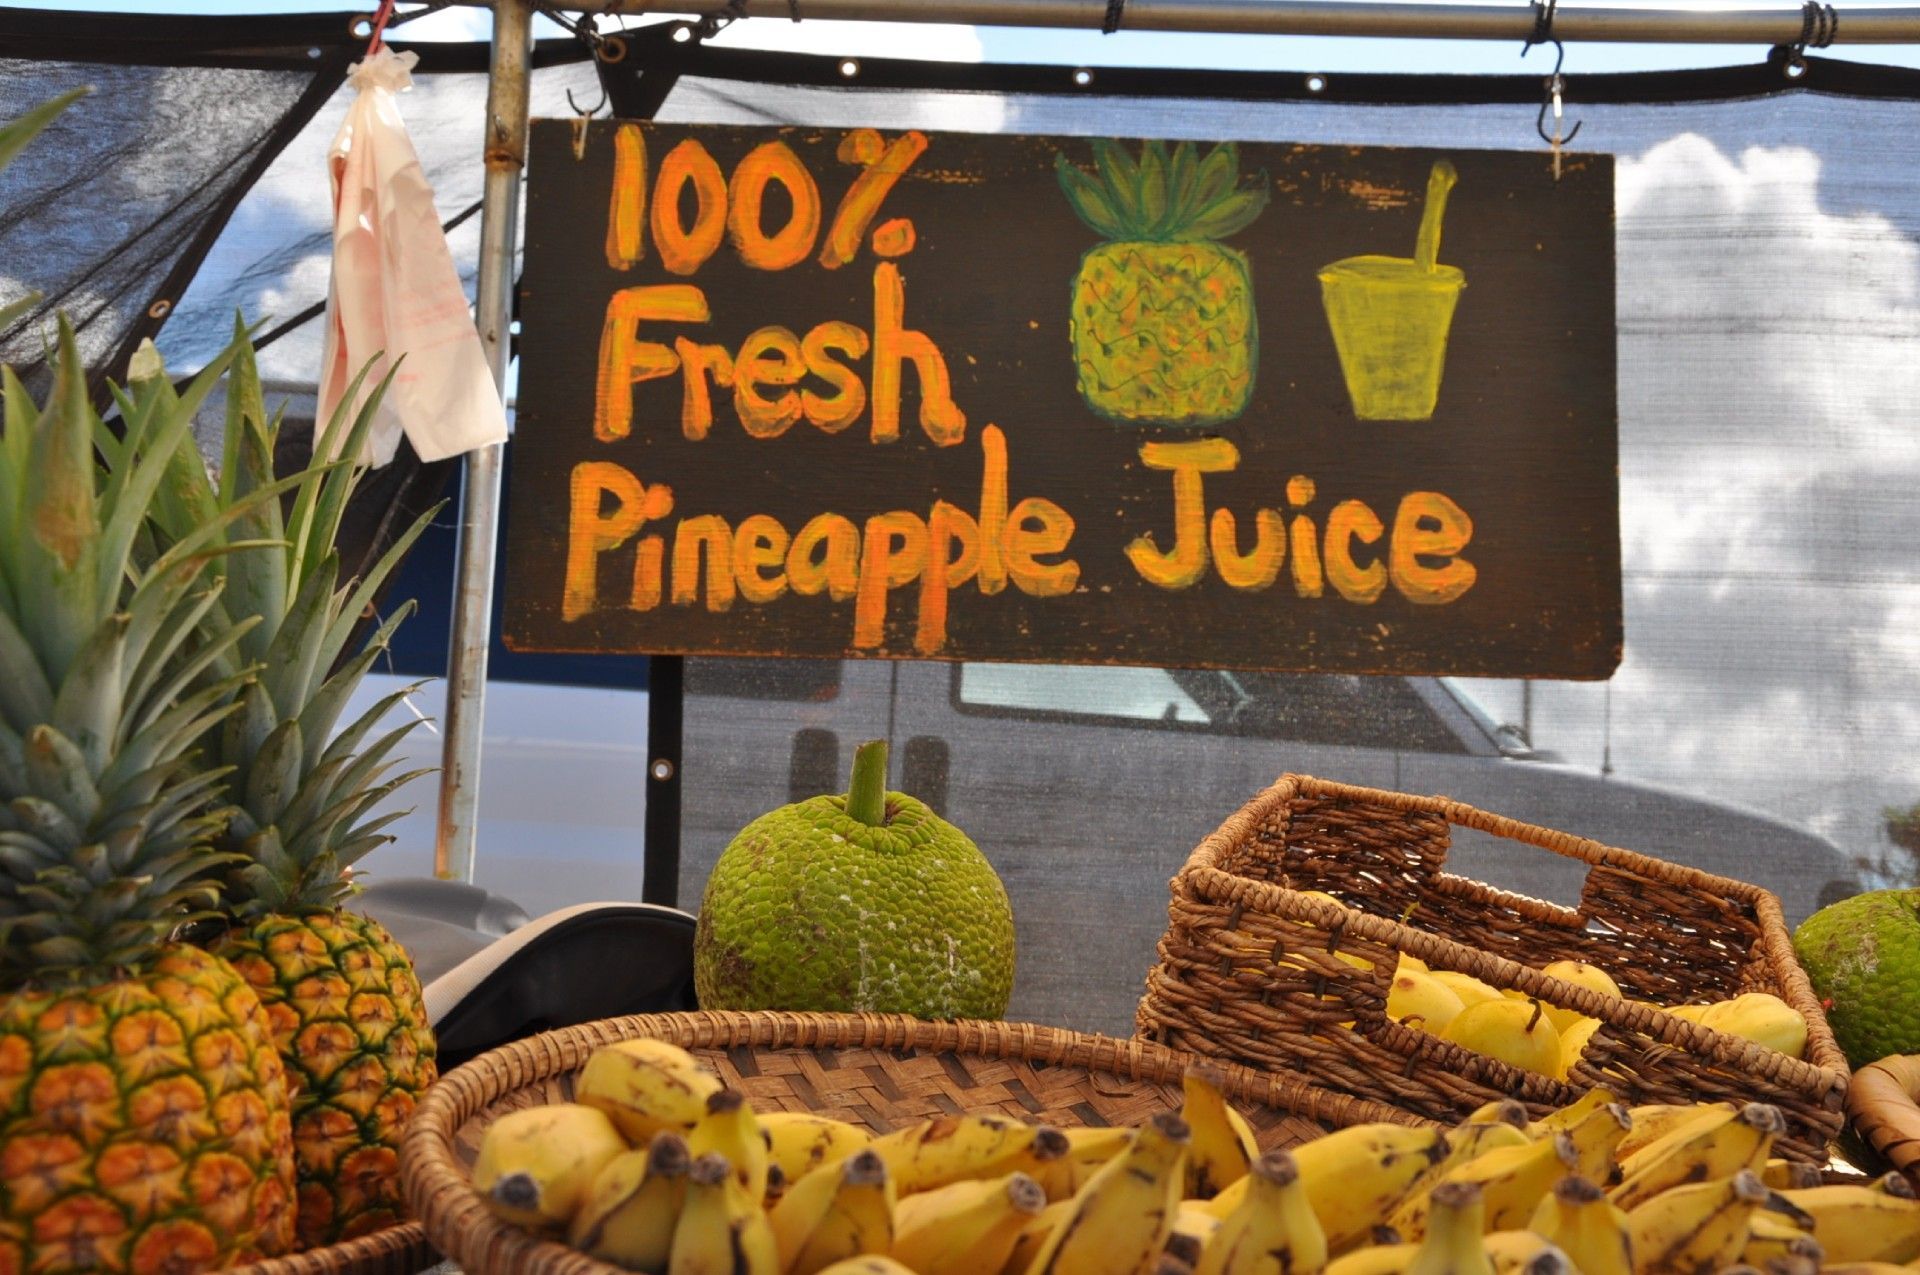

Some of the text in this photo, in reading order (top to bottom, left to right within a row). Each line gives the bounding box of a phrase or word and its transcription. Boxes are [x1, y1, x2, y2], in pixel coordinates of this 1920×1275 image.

[605, 124, 929, 275] 100%
[593, 260, 967, 447] Fresh
[562, 422, 1477, 655] Pineapple Juice
